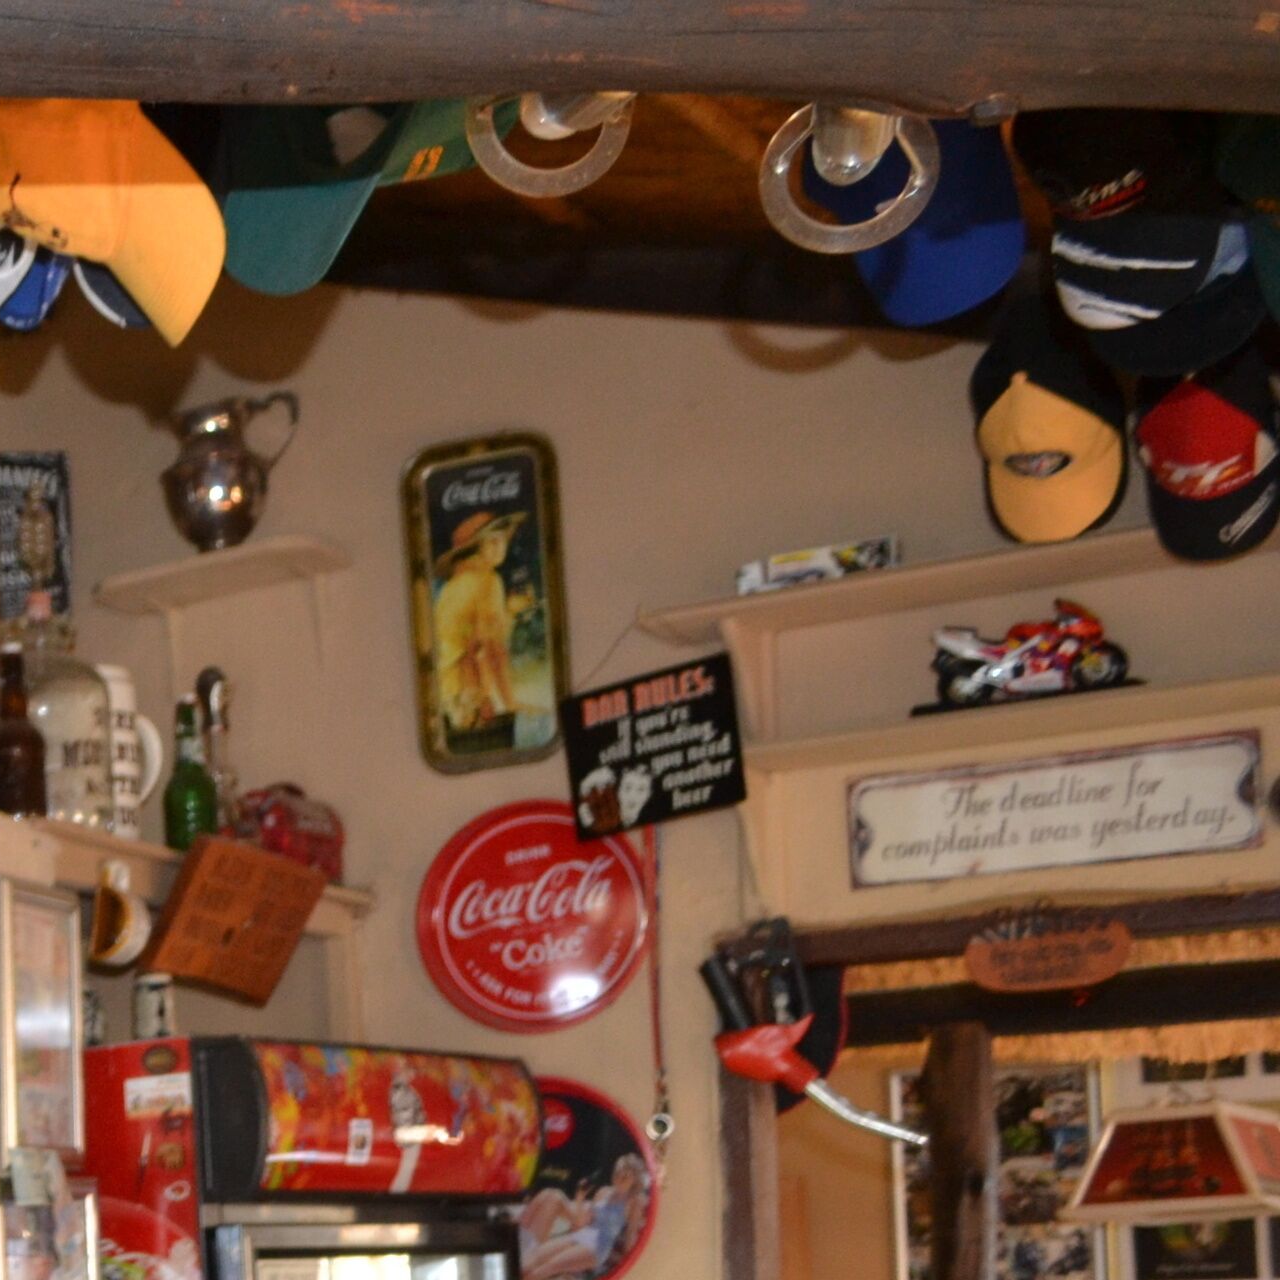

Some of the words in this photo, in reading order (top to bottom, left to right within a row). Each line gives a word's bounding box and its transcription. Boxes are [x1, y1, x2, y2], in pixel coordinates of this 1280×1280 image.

[943, 784, 991, 820] The
[999, 774, 1114, 811] deadline
[1122, 761, 1164, 808] for
[881, 824, 1021, 867] complaints
[1030, 819, 1083, 843] was
[448, 854, 615, 939] Coca-Cola
